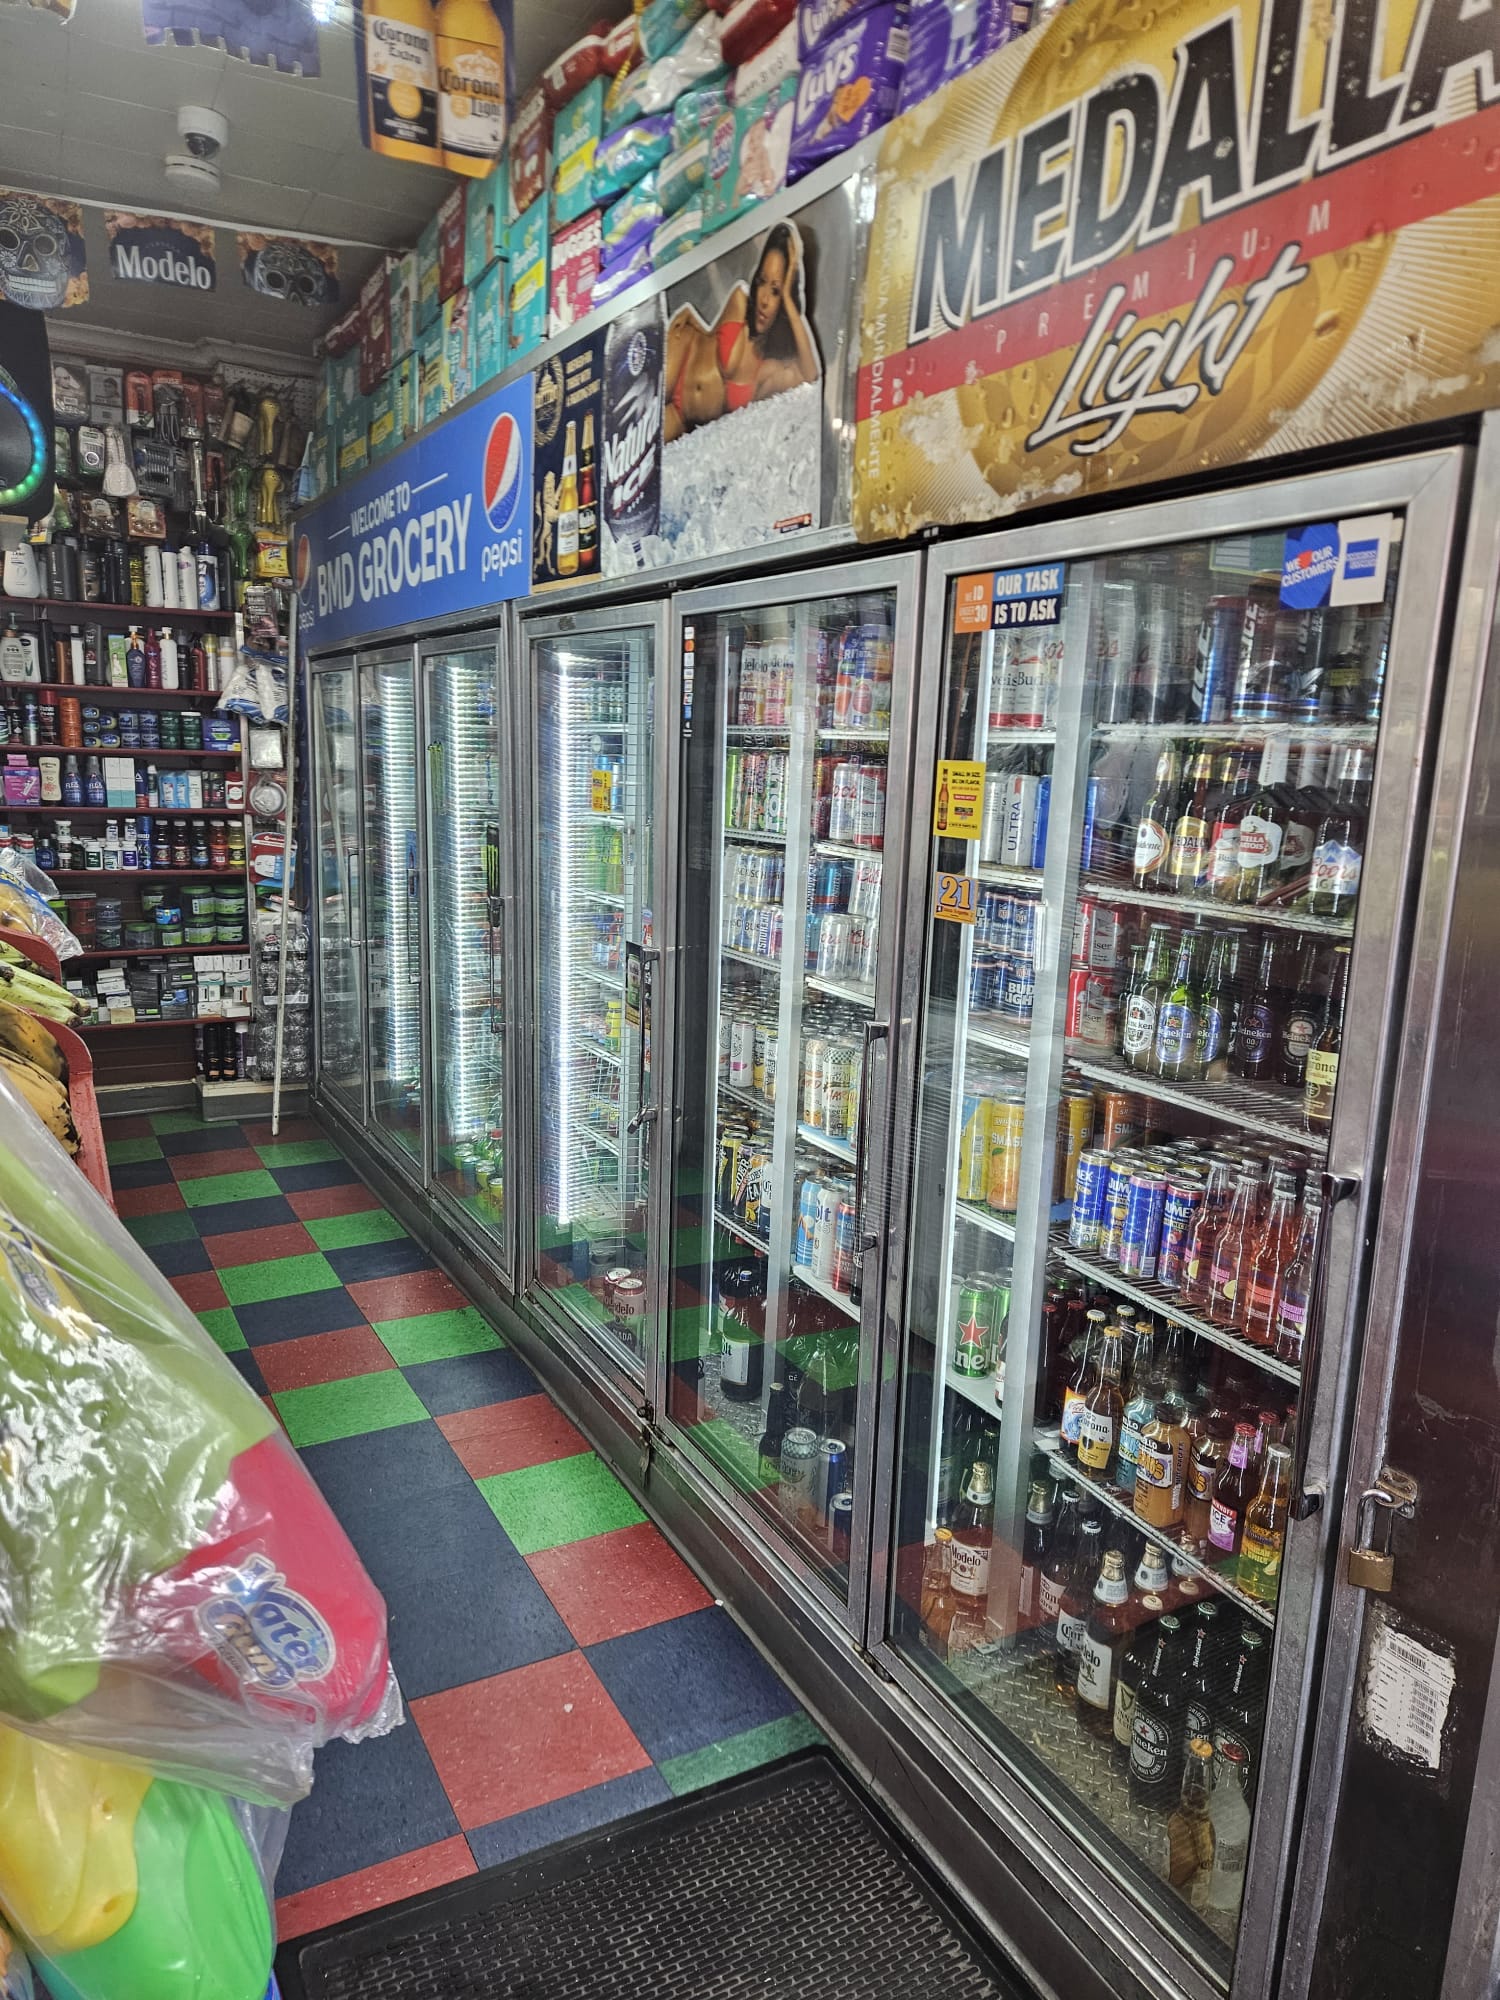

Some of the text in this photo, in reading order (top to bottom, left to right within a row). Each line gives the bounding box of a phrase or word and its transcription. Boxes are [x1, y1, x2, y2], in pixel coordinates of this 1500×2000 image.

[373, 19, 430, 51] Corona
[796, 44, 858, 127] Luvs
[115, 244, 212, 290] Modelo
[1024, 242, 1310, 457] Light
[868, 312, 889, 479] MUNDIALMENTE
[350, 481, 410, 537] WELCOME TO
[317, 493, 472, 617] BMD GROCERY
[481, 528, 522, 582] pepsi
[1285, 558, 1300, 573] WE
[1312, 545, 1333, 563] OUR
[996, 568, 1059, 597] OUR TASK
[1281, 556, 1339, 588] CUSTOMERS
[973, 585, 984, 601] ID
[974, 604, 988, 622] 30
[994, 598, 1057, 624] IS TO ASK
[1007, 801, 1021, 852] ULTRA
[941, 875, 971, 910] 21
[744, 922, 760, 932] BUS
[1005, 992, 1034, 1006] LIGH
[1238, 1028, 1272, 1039] eineken
[1282, 1030, 1312, 1042] Heinek
[992, 1132, 1022, 1147] SMAS
[1108, 1177, 1131, 1193] JUM
[1212, 1507, 1227, 1525] ICE
[1131, 1732, 1167, 1757] ineken
